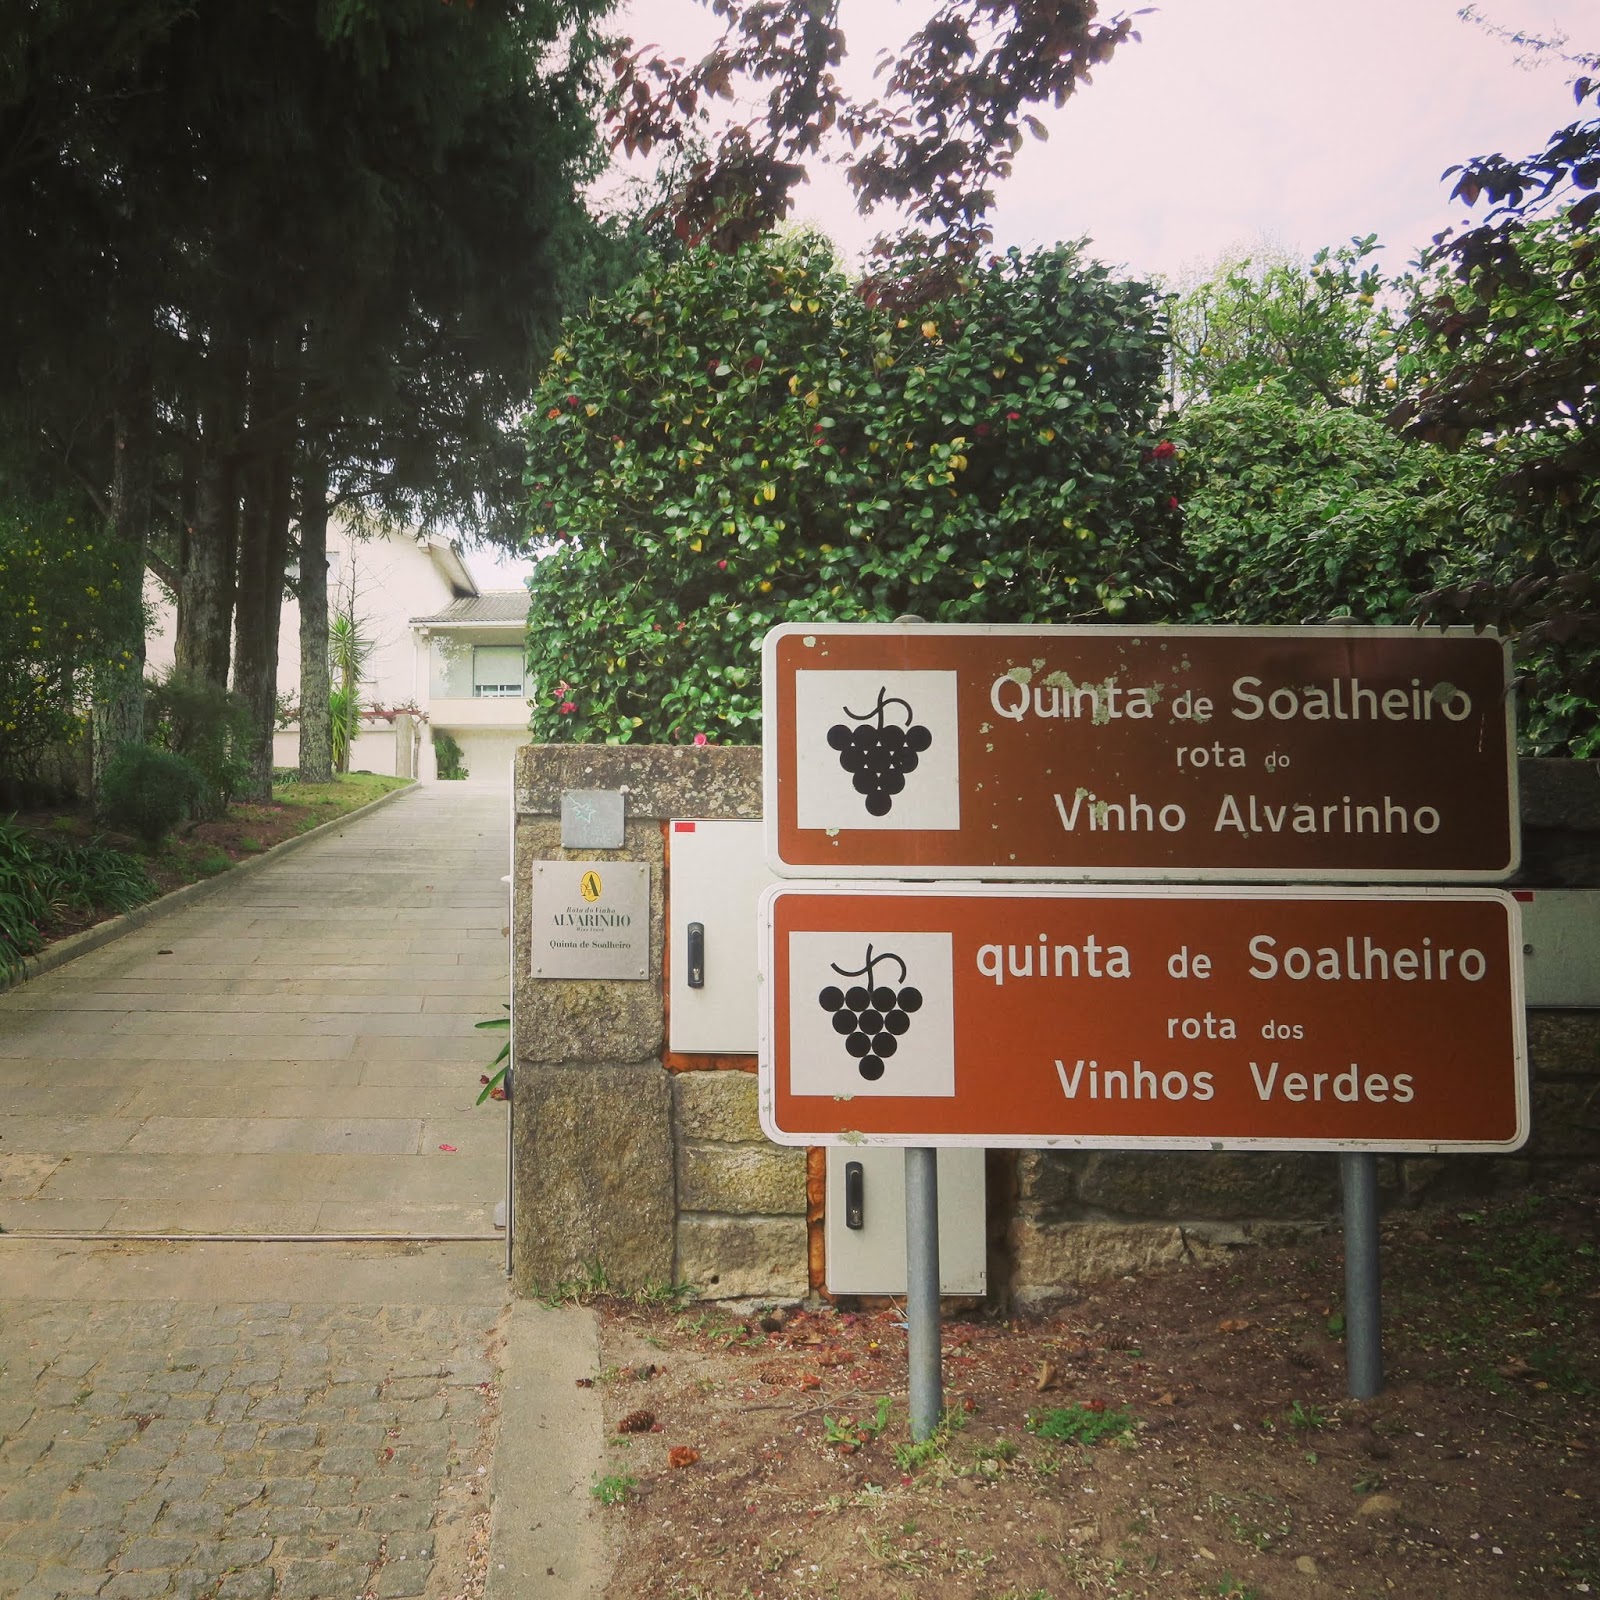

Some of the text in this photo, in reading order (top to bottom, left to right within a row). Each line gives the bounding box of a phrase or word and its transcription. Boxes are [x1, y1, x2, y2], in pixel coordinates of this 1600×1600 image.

[989, 675, 1472, 724] Quinta de Soalheiro
[1176, 743, 1291, 769] rota do
[1054, 793, 1441, 834] Vinho Alvarinho
[551, 914, 631, 927] ALVARINHO
[549, 940, 631, 949] Quinta de Soalheiro
[977, 933, 1487, 985] quinta de Soalheiro
[1167, 1012, 1304, 1041] rota dos
[1055, 1060, 1415, 1103] Vinhos Verdes
